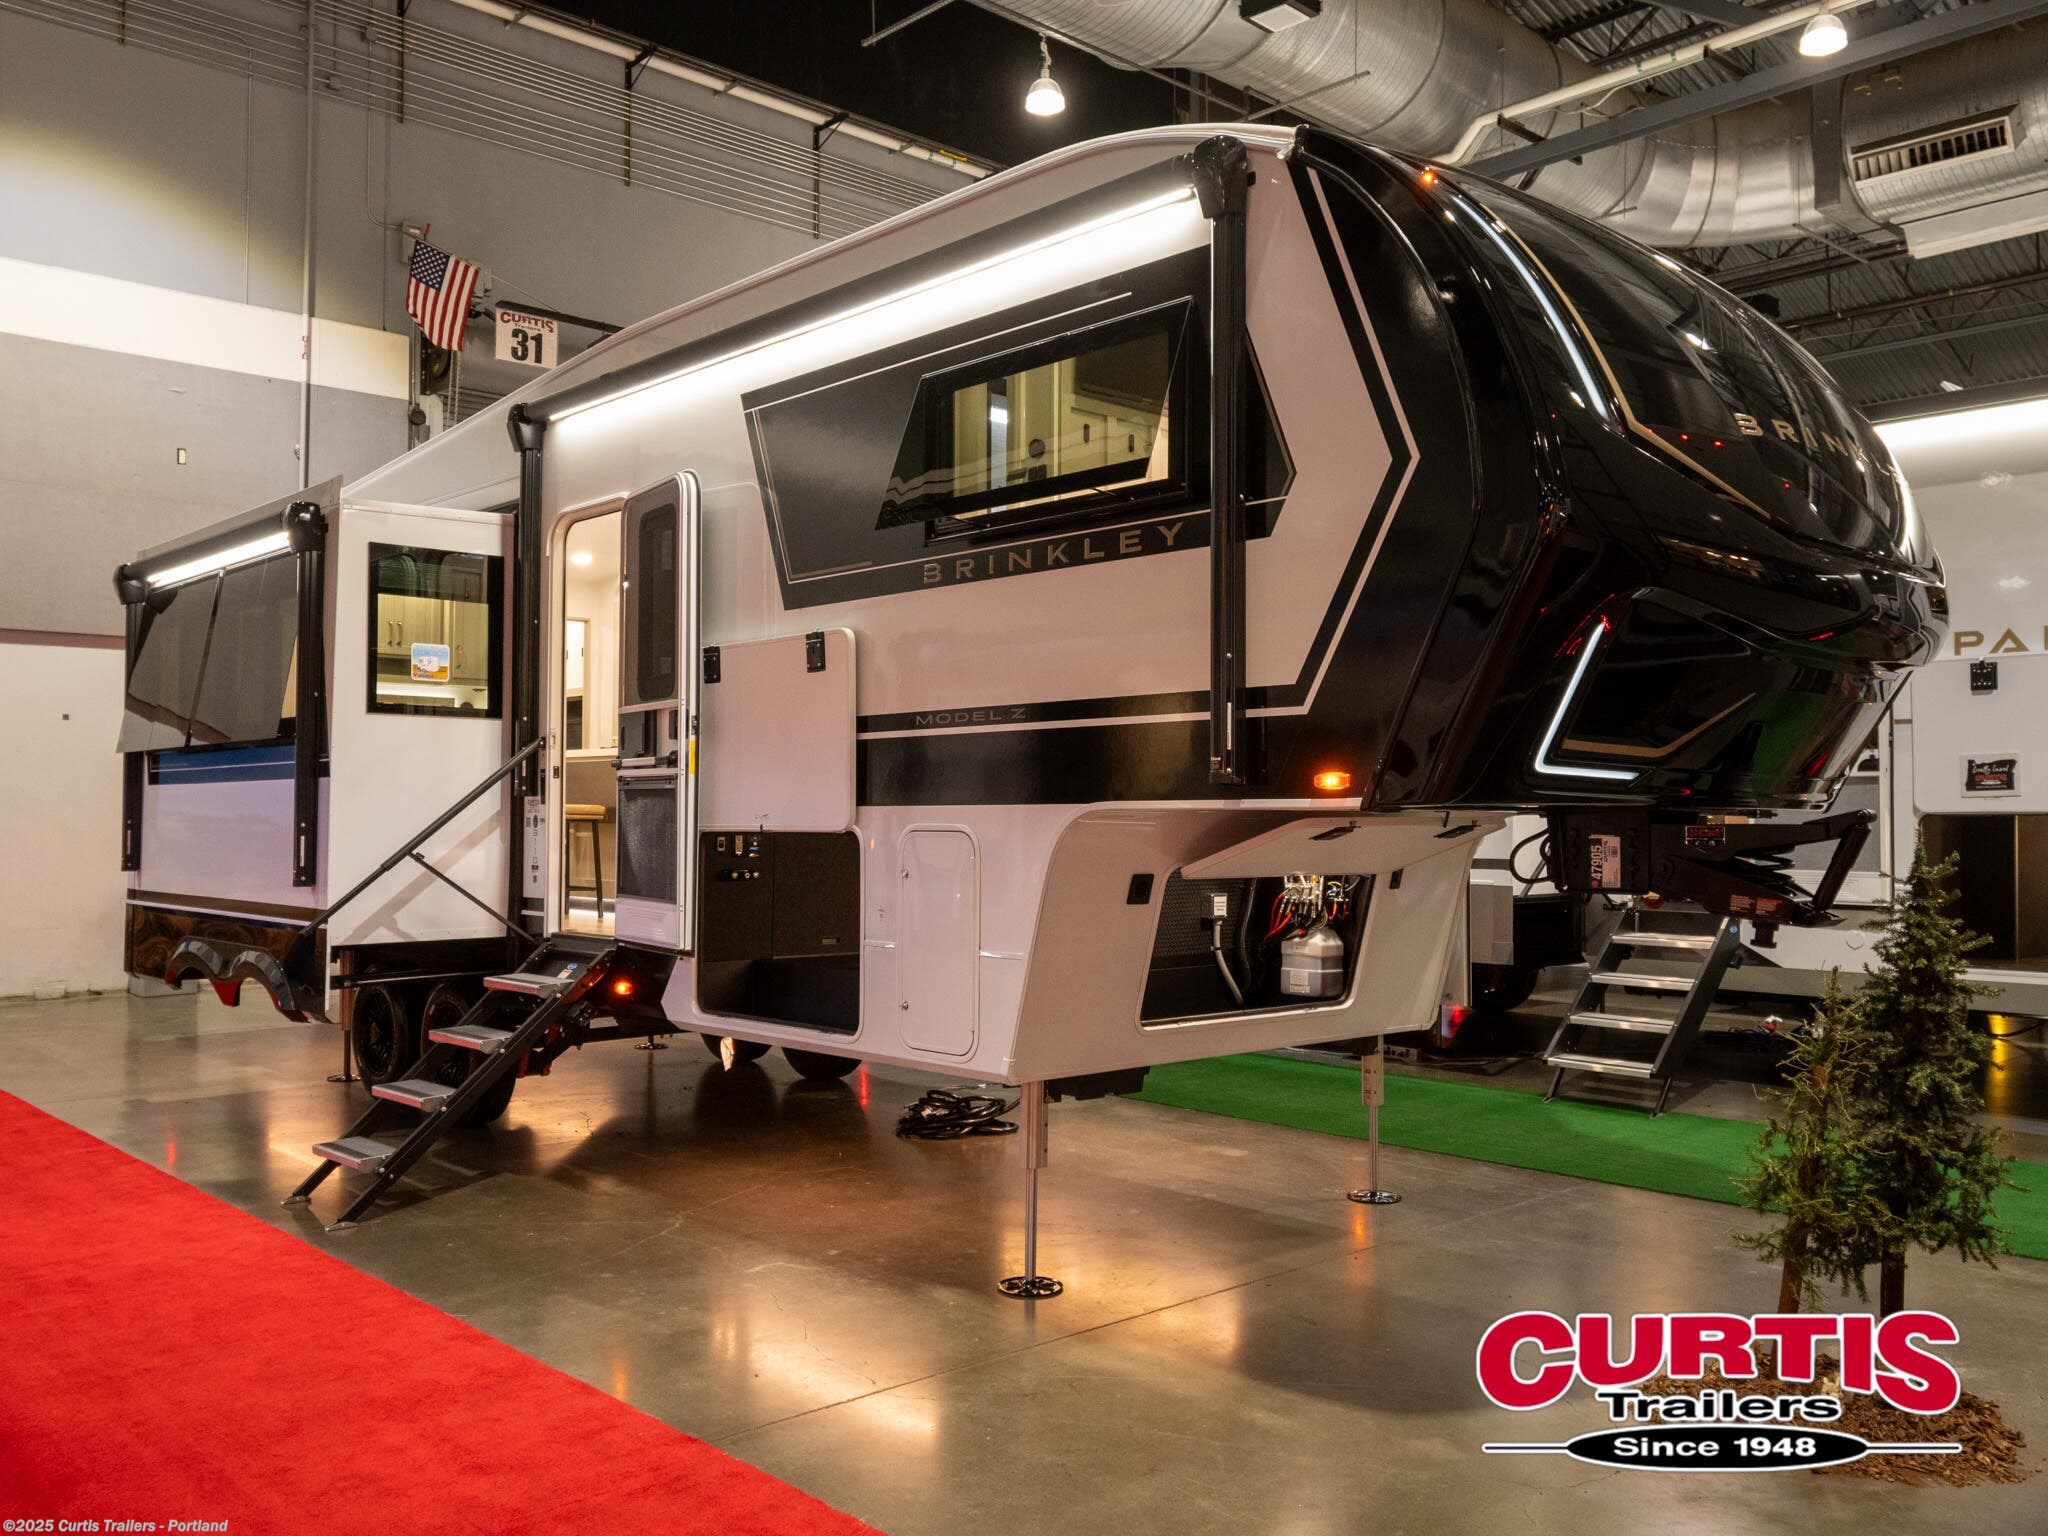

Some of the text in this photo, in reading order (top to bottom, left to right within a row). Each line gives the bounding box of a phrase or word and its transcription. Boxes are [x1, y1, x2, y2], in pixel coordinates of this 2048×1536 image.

[500, 311, 554, 333] CURTIS
[511, 328, 542, 364] 31
[923, 522, 1184, 584] BRINKLEY
[1954, 625, 2048, 656] PA
[916, 707, 1026, 726] MODEL Z
[1590, 844, 1602, 881] 47905
